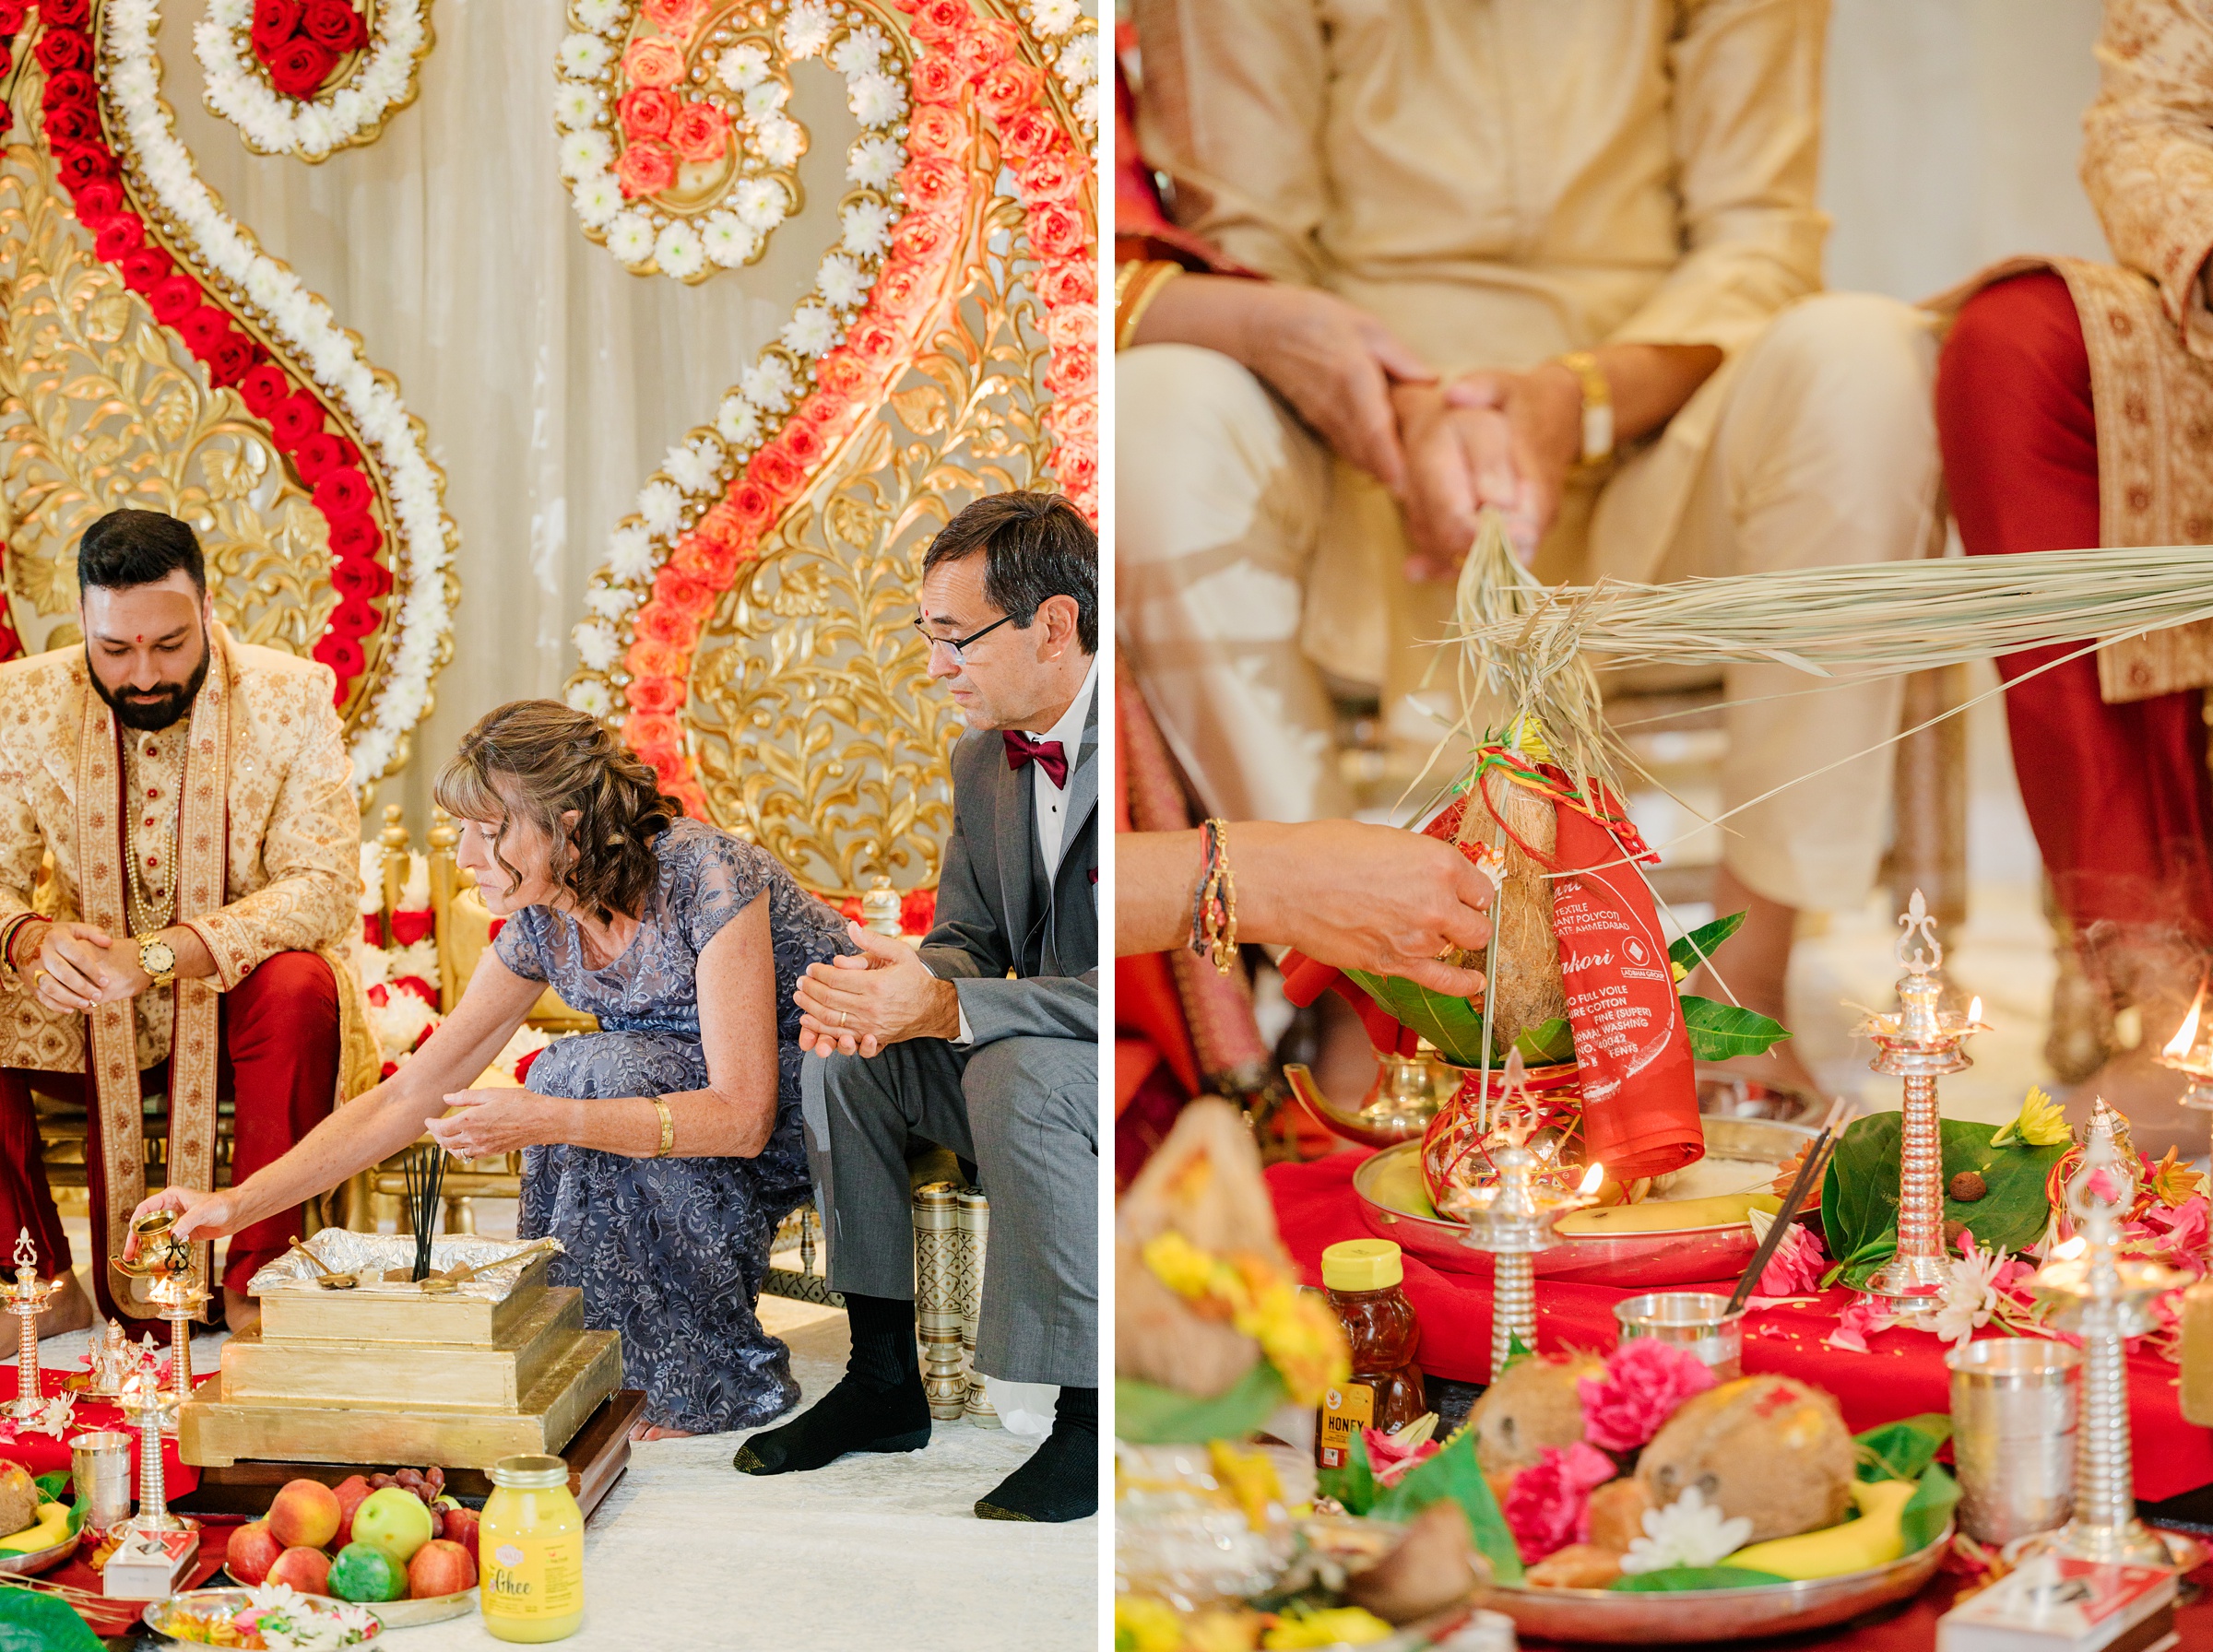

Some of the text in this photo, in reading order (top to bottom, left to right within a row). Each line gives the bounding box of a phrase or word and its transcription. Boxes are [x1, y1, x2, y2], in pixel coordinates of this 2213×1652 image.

[1556, 903, 1588, 916] TEXTILE
[1575, 921, 1630, 934] AHMEDABAD
[1578, 991, 1599, 1004] FULL
[1599, 985, 1628, 997] VOILE
[1588, 997, 1627, 1013] COTTON
[1593, 1006, 1652, 1025] FINE (SUPER)
[1602, 1019, 1649, 1033] WASHING
[1599, 1034, 1626, 1048] 40042
[496, 1569, 530, 1595] Ghee
